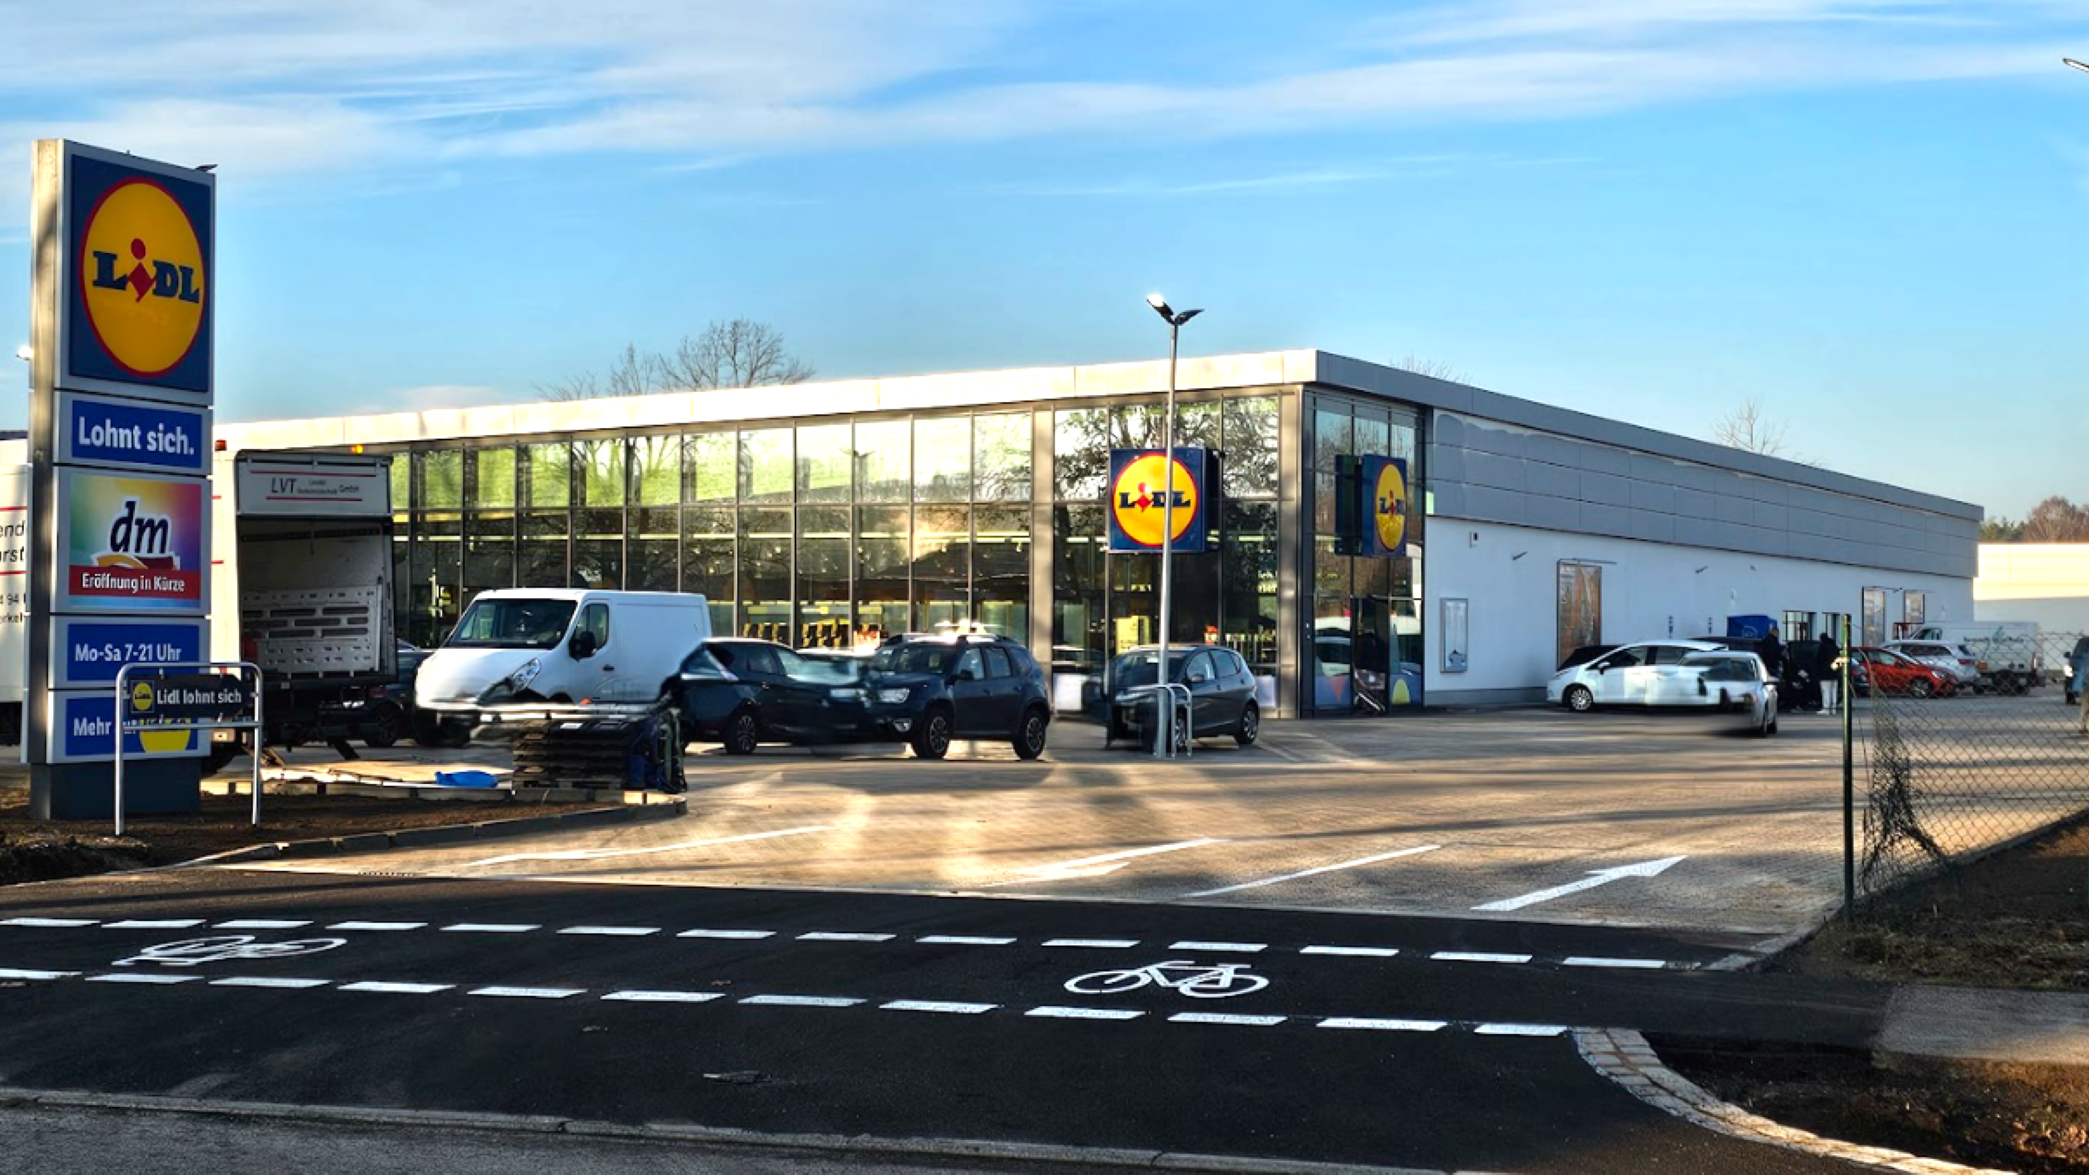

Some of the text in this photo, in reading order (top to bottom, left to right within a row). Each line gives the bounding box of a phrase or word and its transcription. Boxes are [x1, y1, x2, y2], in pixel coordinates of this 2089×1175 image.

[79, 416, 195, 455] Lohnt sich.
[271, 478, 297, 493] LVT
[110, 500, 169, 554] dm
[0, 545, 25, 562] rst
[82, 573, 185, 593] Eröffnung in Kürze
[75, 643, 182, 662] Mo-Sa 7-21 Uhr
[156, 687, 242, 705] Lidl lohnt sich
[73, 717, 112, 736] Mehr
